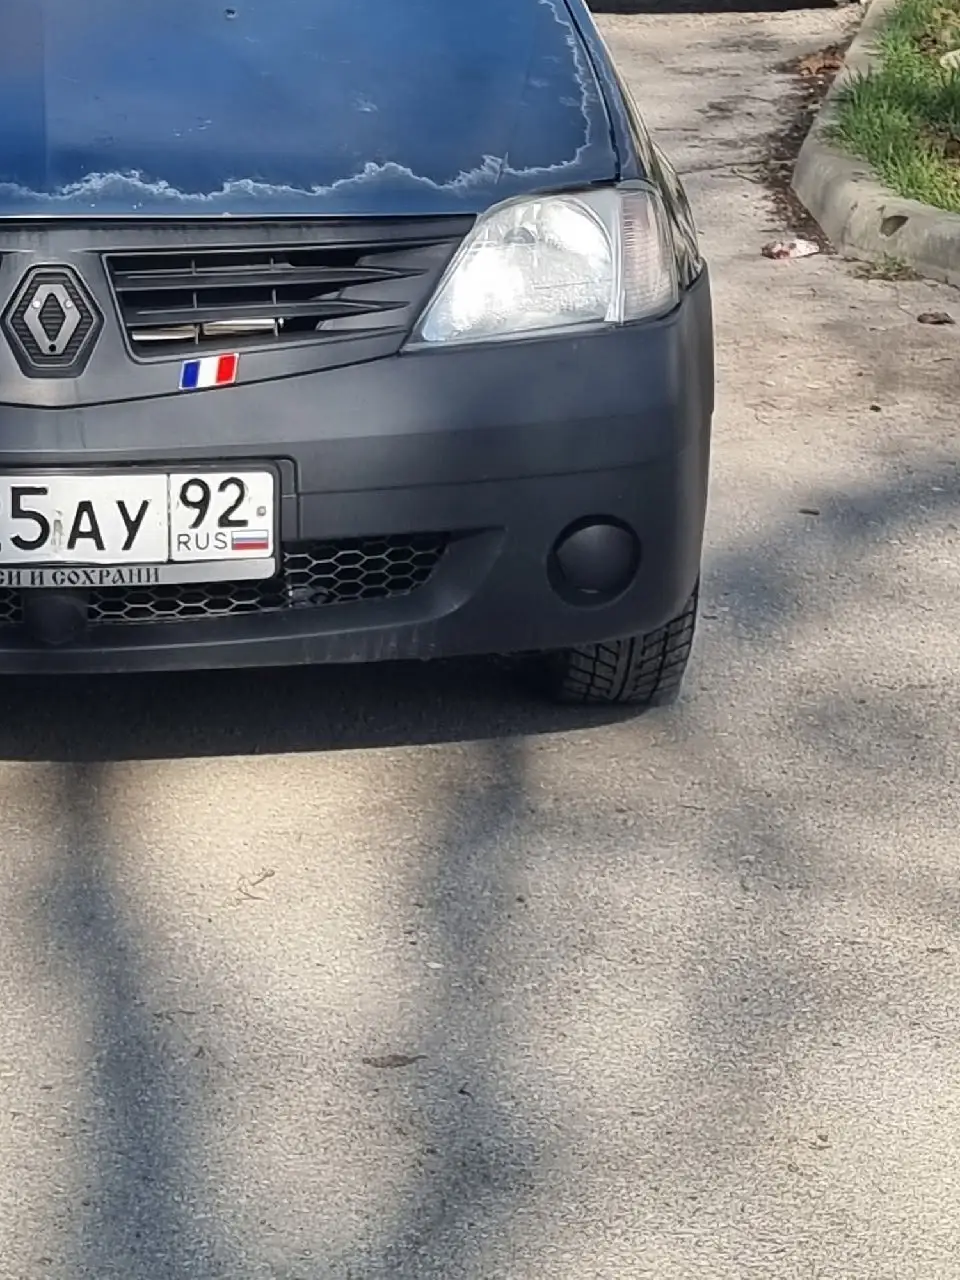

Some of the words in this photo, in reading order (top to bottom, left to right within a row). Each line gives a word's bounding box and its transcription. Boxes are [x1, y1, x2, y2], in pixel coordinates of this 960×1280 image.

[179, 477, 249, 528] 92
[176, 533, 228, 551] RUS
[30, 570, 45, 585] И
[51, 567, 160, 585] СОХРАНИ
